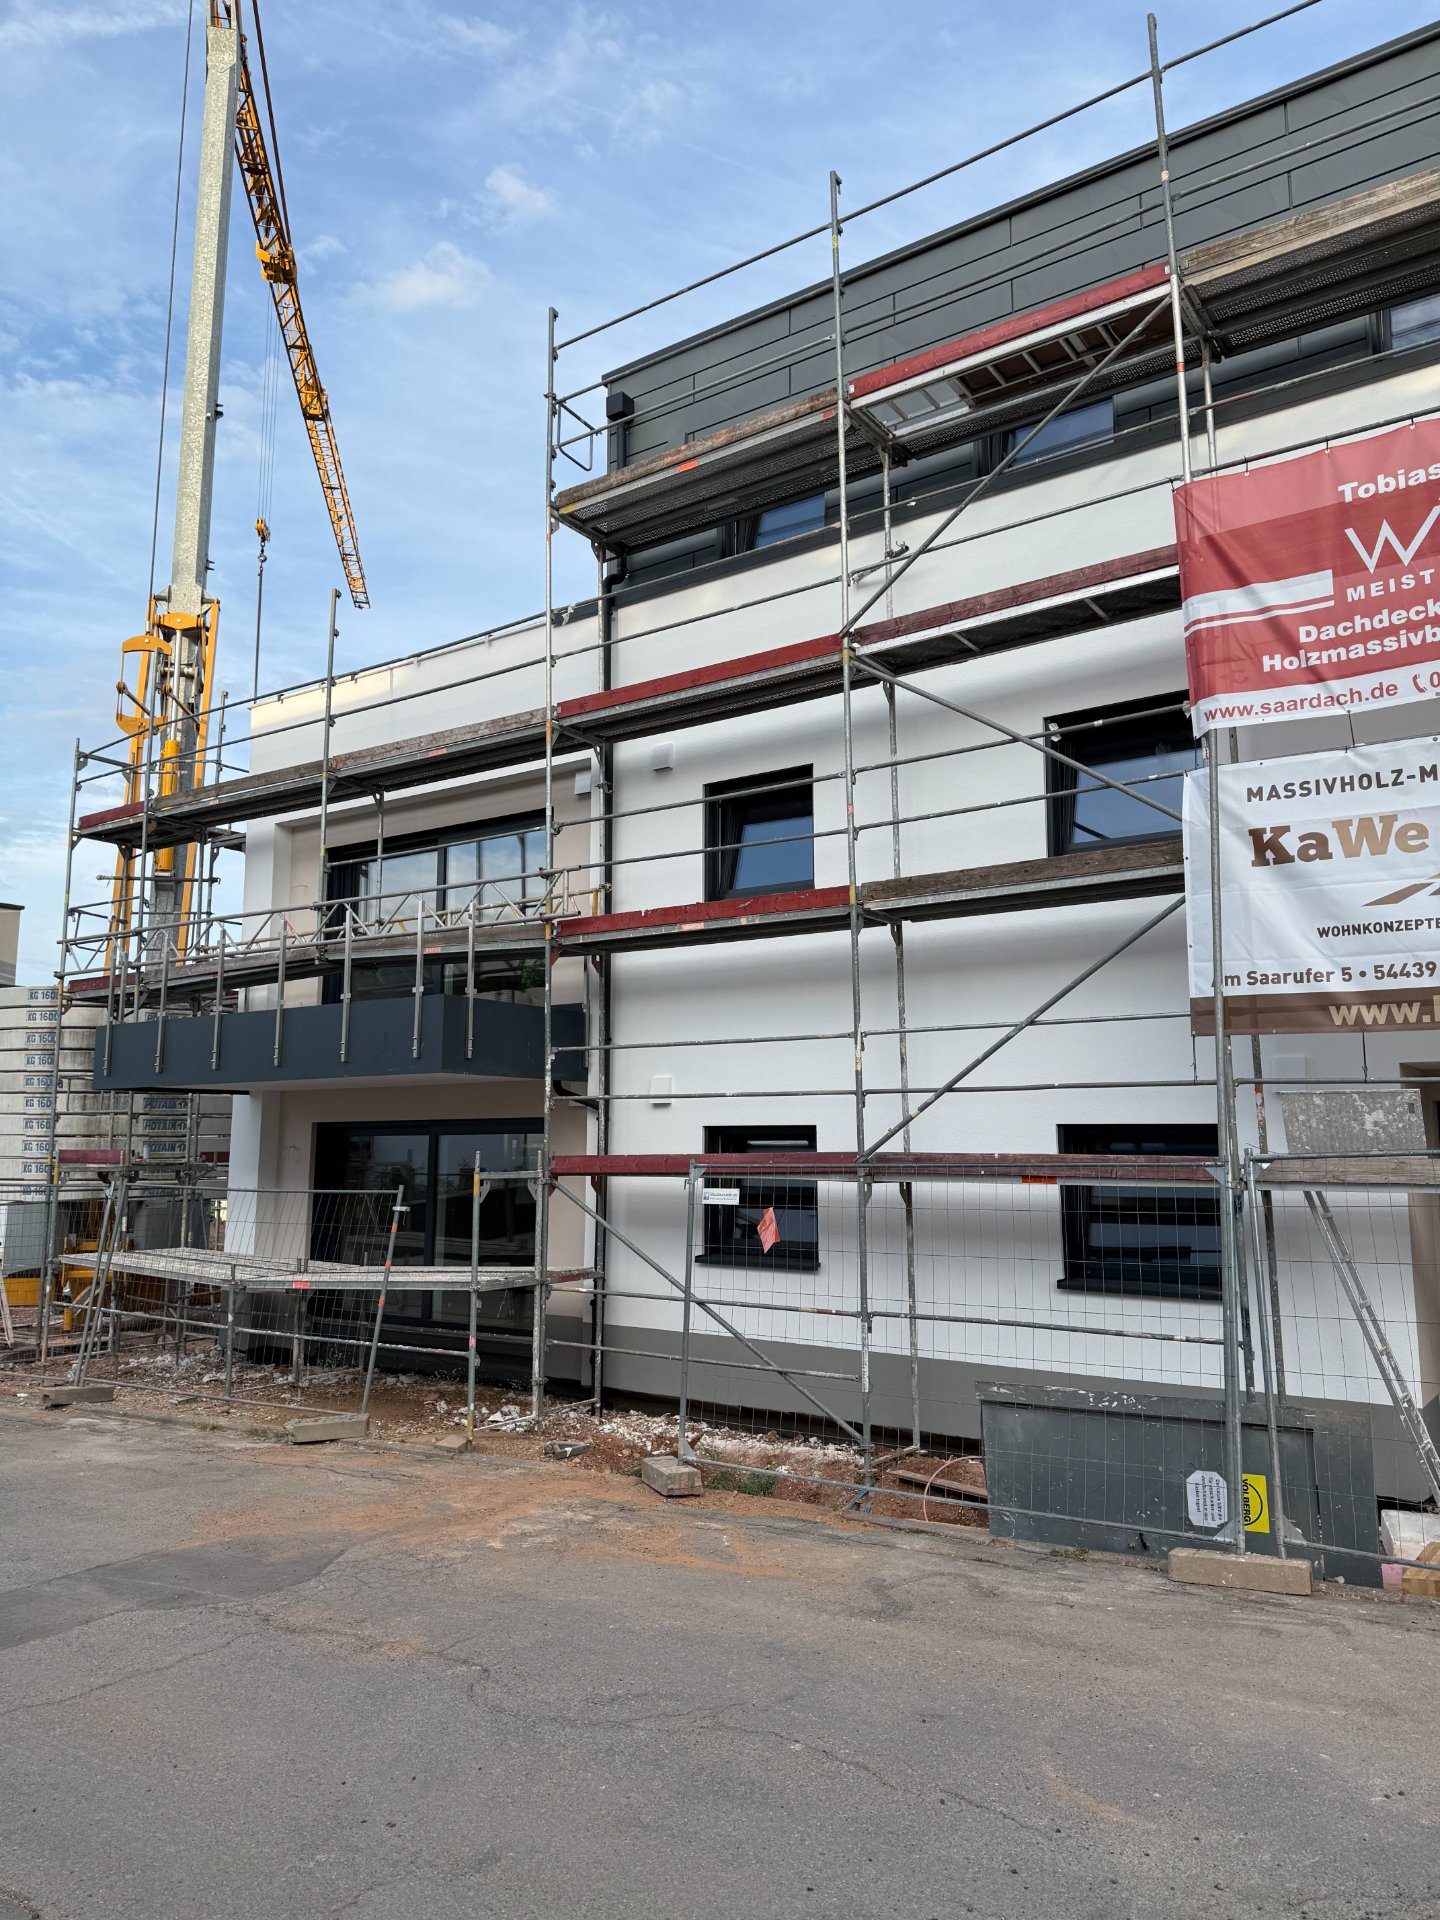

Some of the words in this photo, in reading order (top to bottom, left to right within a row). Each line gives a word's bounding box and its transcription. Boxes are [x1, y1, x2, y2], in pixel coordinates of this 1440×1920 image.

[1338, 463, 1440, 503] Tobias
[1347, 569, 1435, 602] MEIST
[1299, 599, 1440, 643] Dachdeck
[1263, 625, 1440, 672] Holzmassivb
[1204, 682, 1398, 722] www.saardach.de
[1247, 764, 1438, 803] MASSIVHOLZ-M
[1248, 813, 1429, 868] KaWe
[1211, 974, 1241, 987] m
[1246, 968, 1335, 986] Saarufer
[1341, 967, 1353, 982] 5
[1373, 961, 1437, 980] 54439
[1242, 1478, 1252, 1523] VOLBERG
